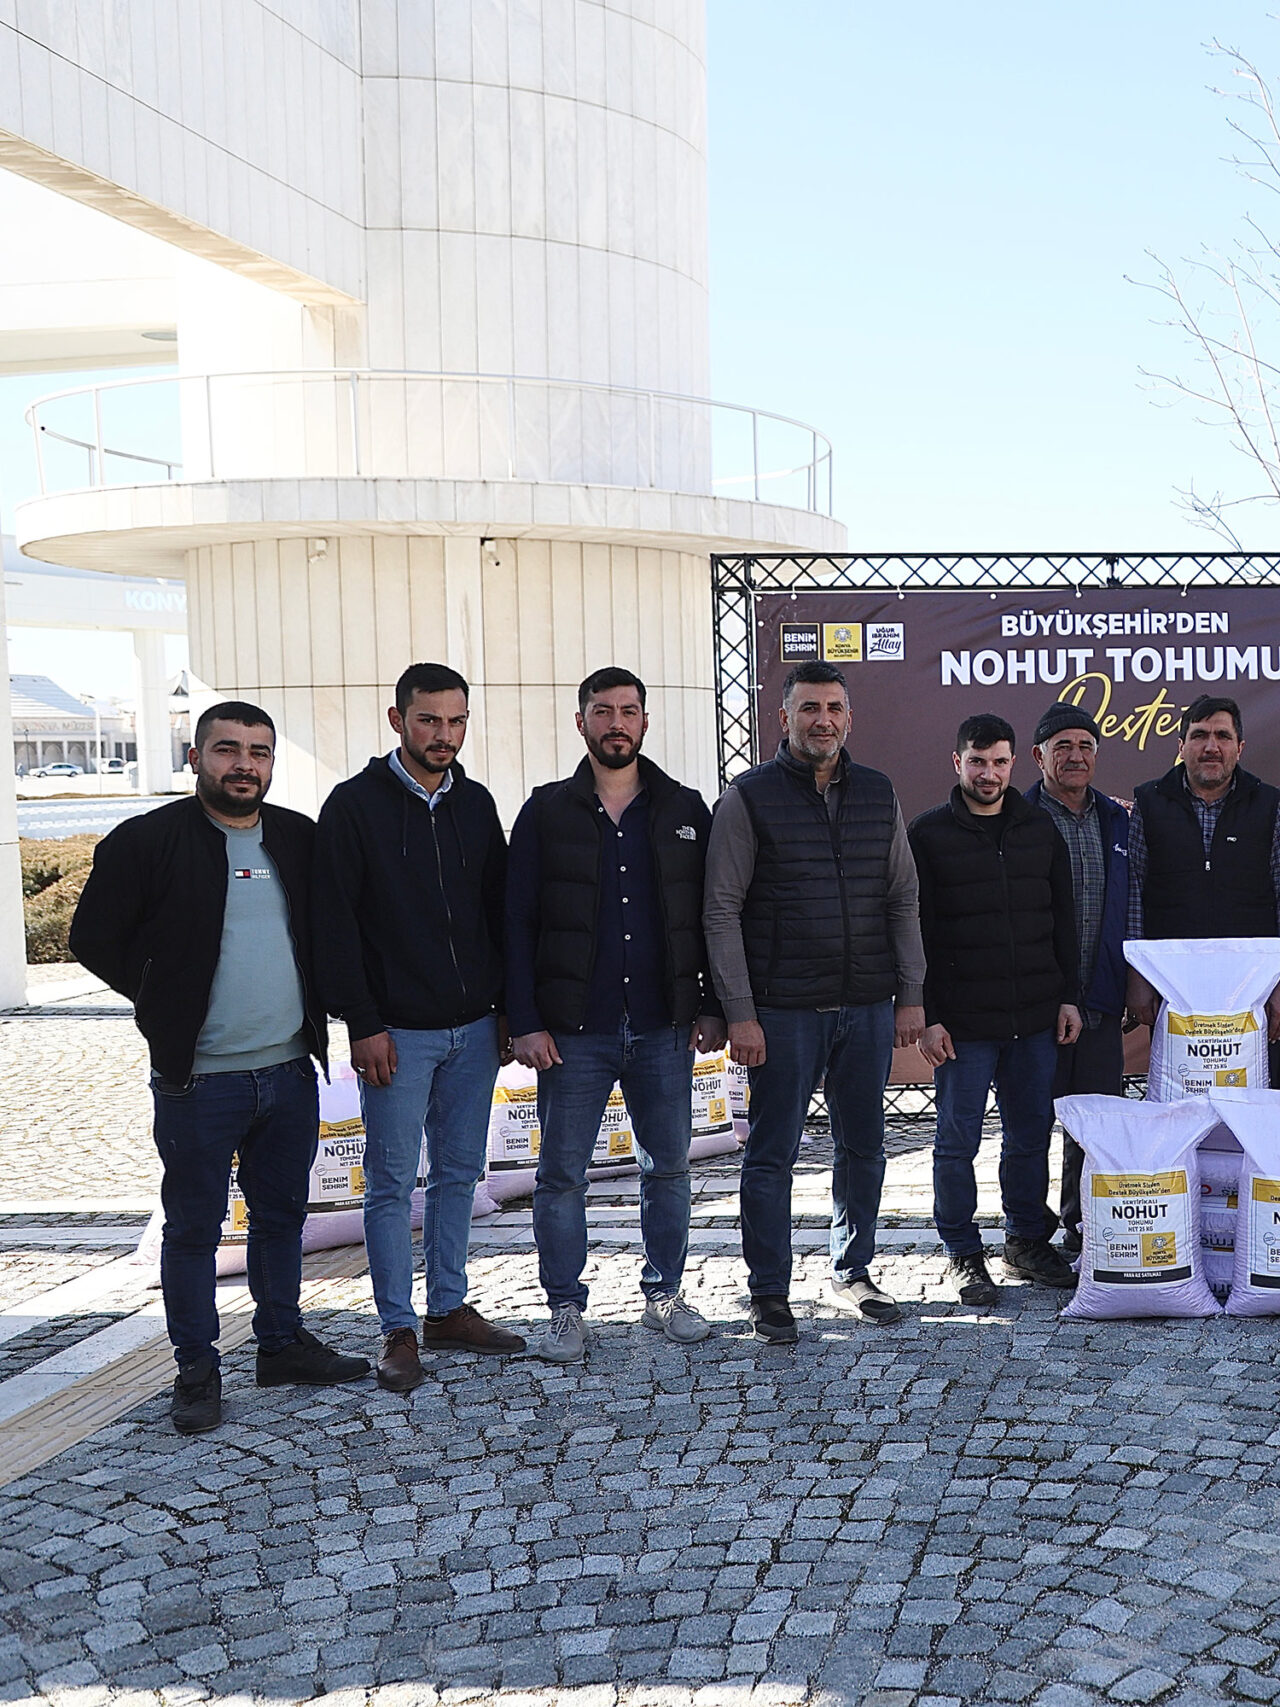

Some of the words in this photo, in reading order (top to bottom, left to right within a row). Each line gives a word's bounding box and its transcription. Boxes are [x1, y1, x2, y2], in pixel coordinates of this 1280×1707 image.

[123, 590, 187, 612] KONY
[784, 632, 817, 643] BENİM
[784, 643, 817, 654] ŞEHRİM
[941, 648, 1094, 686] NOHUT
[1057, 672, 1190, 766] Deste
[1187, 1042, 1242, 1057] NOHUT
[1184, 1079, 1212, 1087] BENİM
[507, 1109, 536, 1120] NOH
[601, 1111, 628, 1123] OHUT
[321, 1176, 348, 1184] BENİM
[322, 1183, 348, 1191] ŞEHRİM
[1111, 1204, 1168, 1219] NOHUT
[1109, 1243, 1138, 1251] BENİM
[1110, 1251, 1138, 1259] ŞEHRİM
